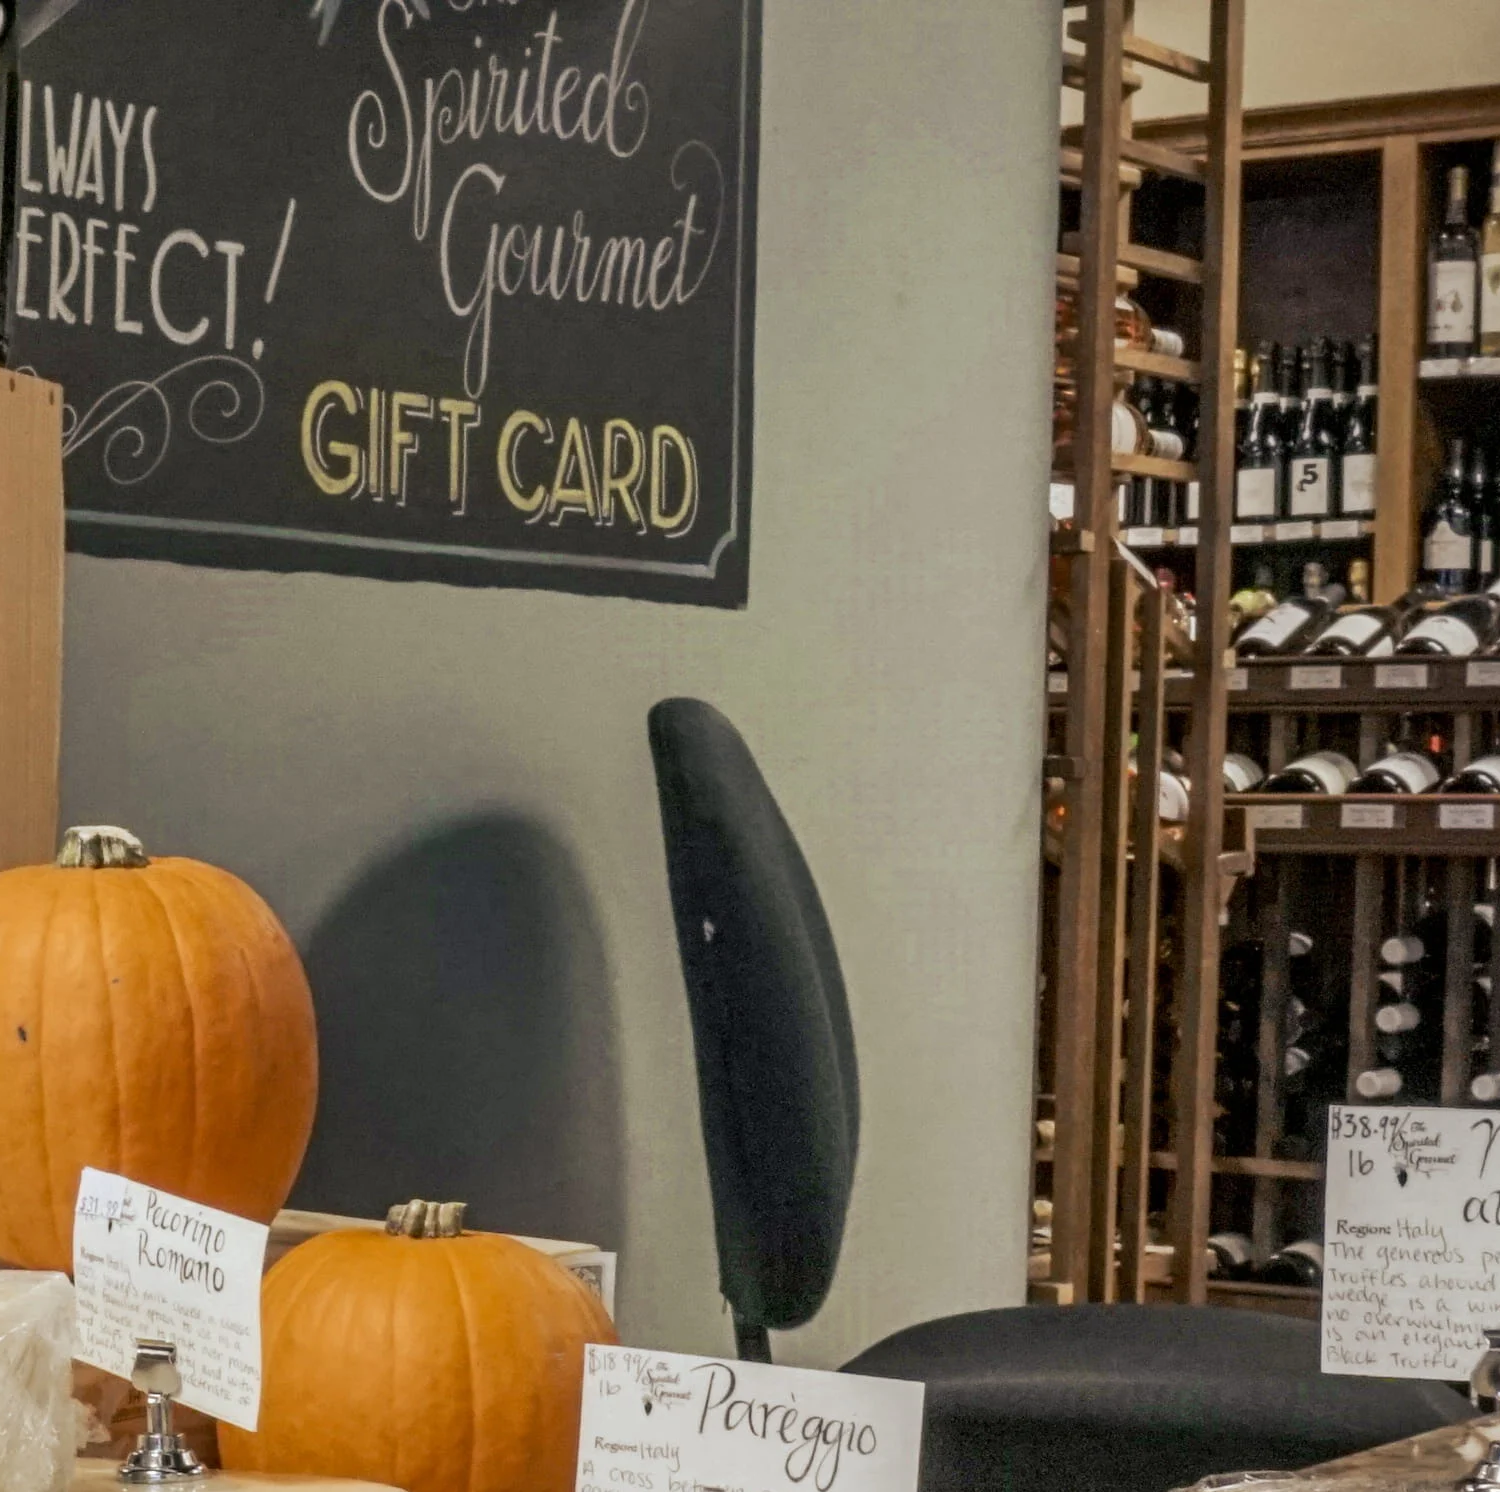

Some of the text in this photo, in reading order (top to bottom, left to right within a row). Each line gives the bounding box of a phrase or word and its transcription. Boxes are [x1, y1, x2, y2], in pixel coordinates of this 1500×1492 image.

[20, 80, 159, 213] LWAYS
[348, 0, 648, 240] Spirited
[14, 198, 296, 359] ERFECT!
[439, 140, 724, 398] Gourmet
[302, 379, 700, 538] GIFT CARD
[1348, 1149, 1374, 1177] lb
[147, 1190, 225, 1253] Pecorino
[1329, 1242, 1364, 1260] The
[1397, 1217, 1446, 1252] Italy
[137, 1228, 225, 1294] Romano
[1419, 1274, 1497, 1293] abound
[640, 1441, 680, 1473] Italy
[690, 1362, 877, 1492] Parèggio
[609, 1467, 654, 1489] cross
